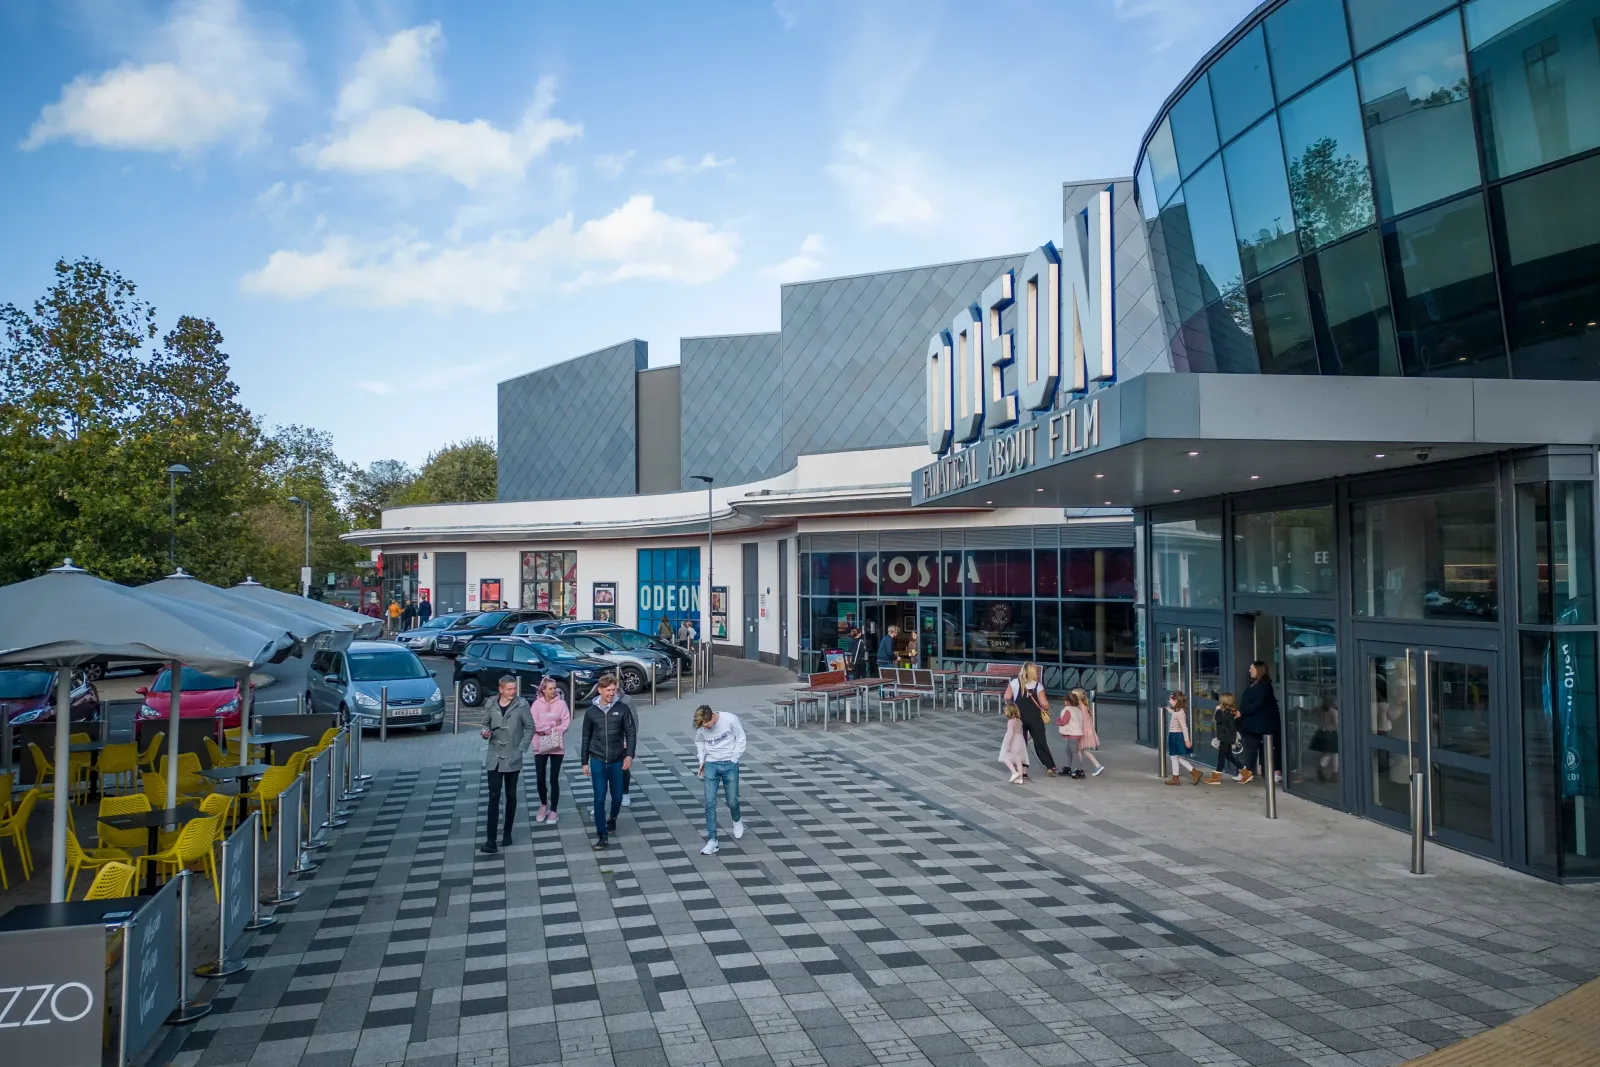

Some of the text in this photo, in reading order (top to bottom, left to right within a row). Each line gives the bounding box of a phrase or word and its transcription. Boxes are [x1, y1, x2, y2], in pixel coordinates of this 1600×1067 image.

[926, 184, 1117, 457] ODEON
[922, 398, 1100, 499] FANATICAL ABOUT FILM
[640, 584, 701, 612] ODEON
[865, 555, 981, 588] COSTA
